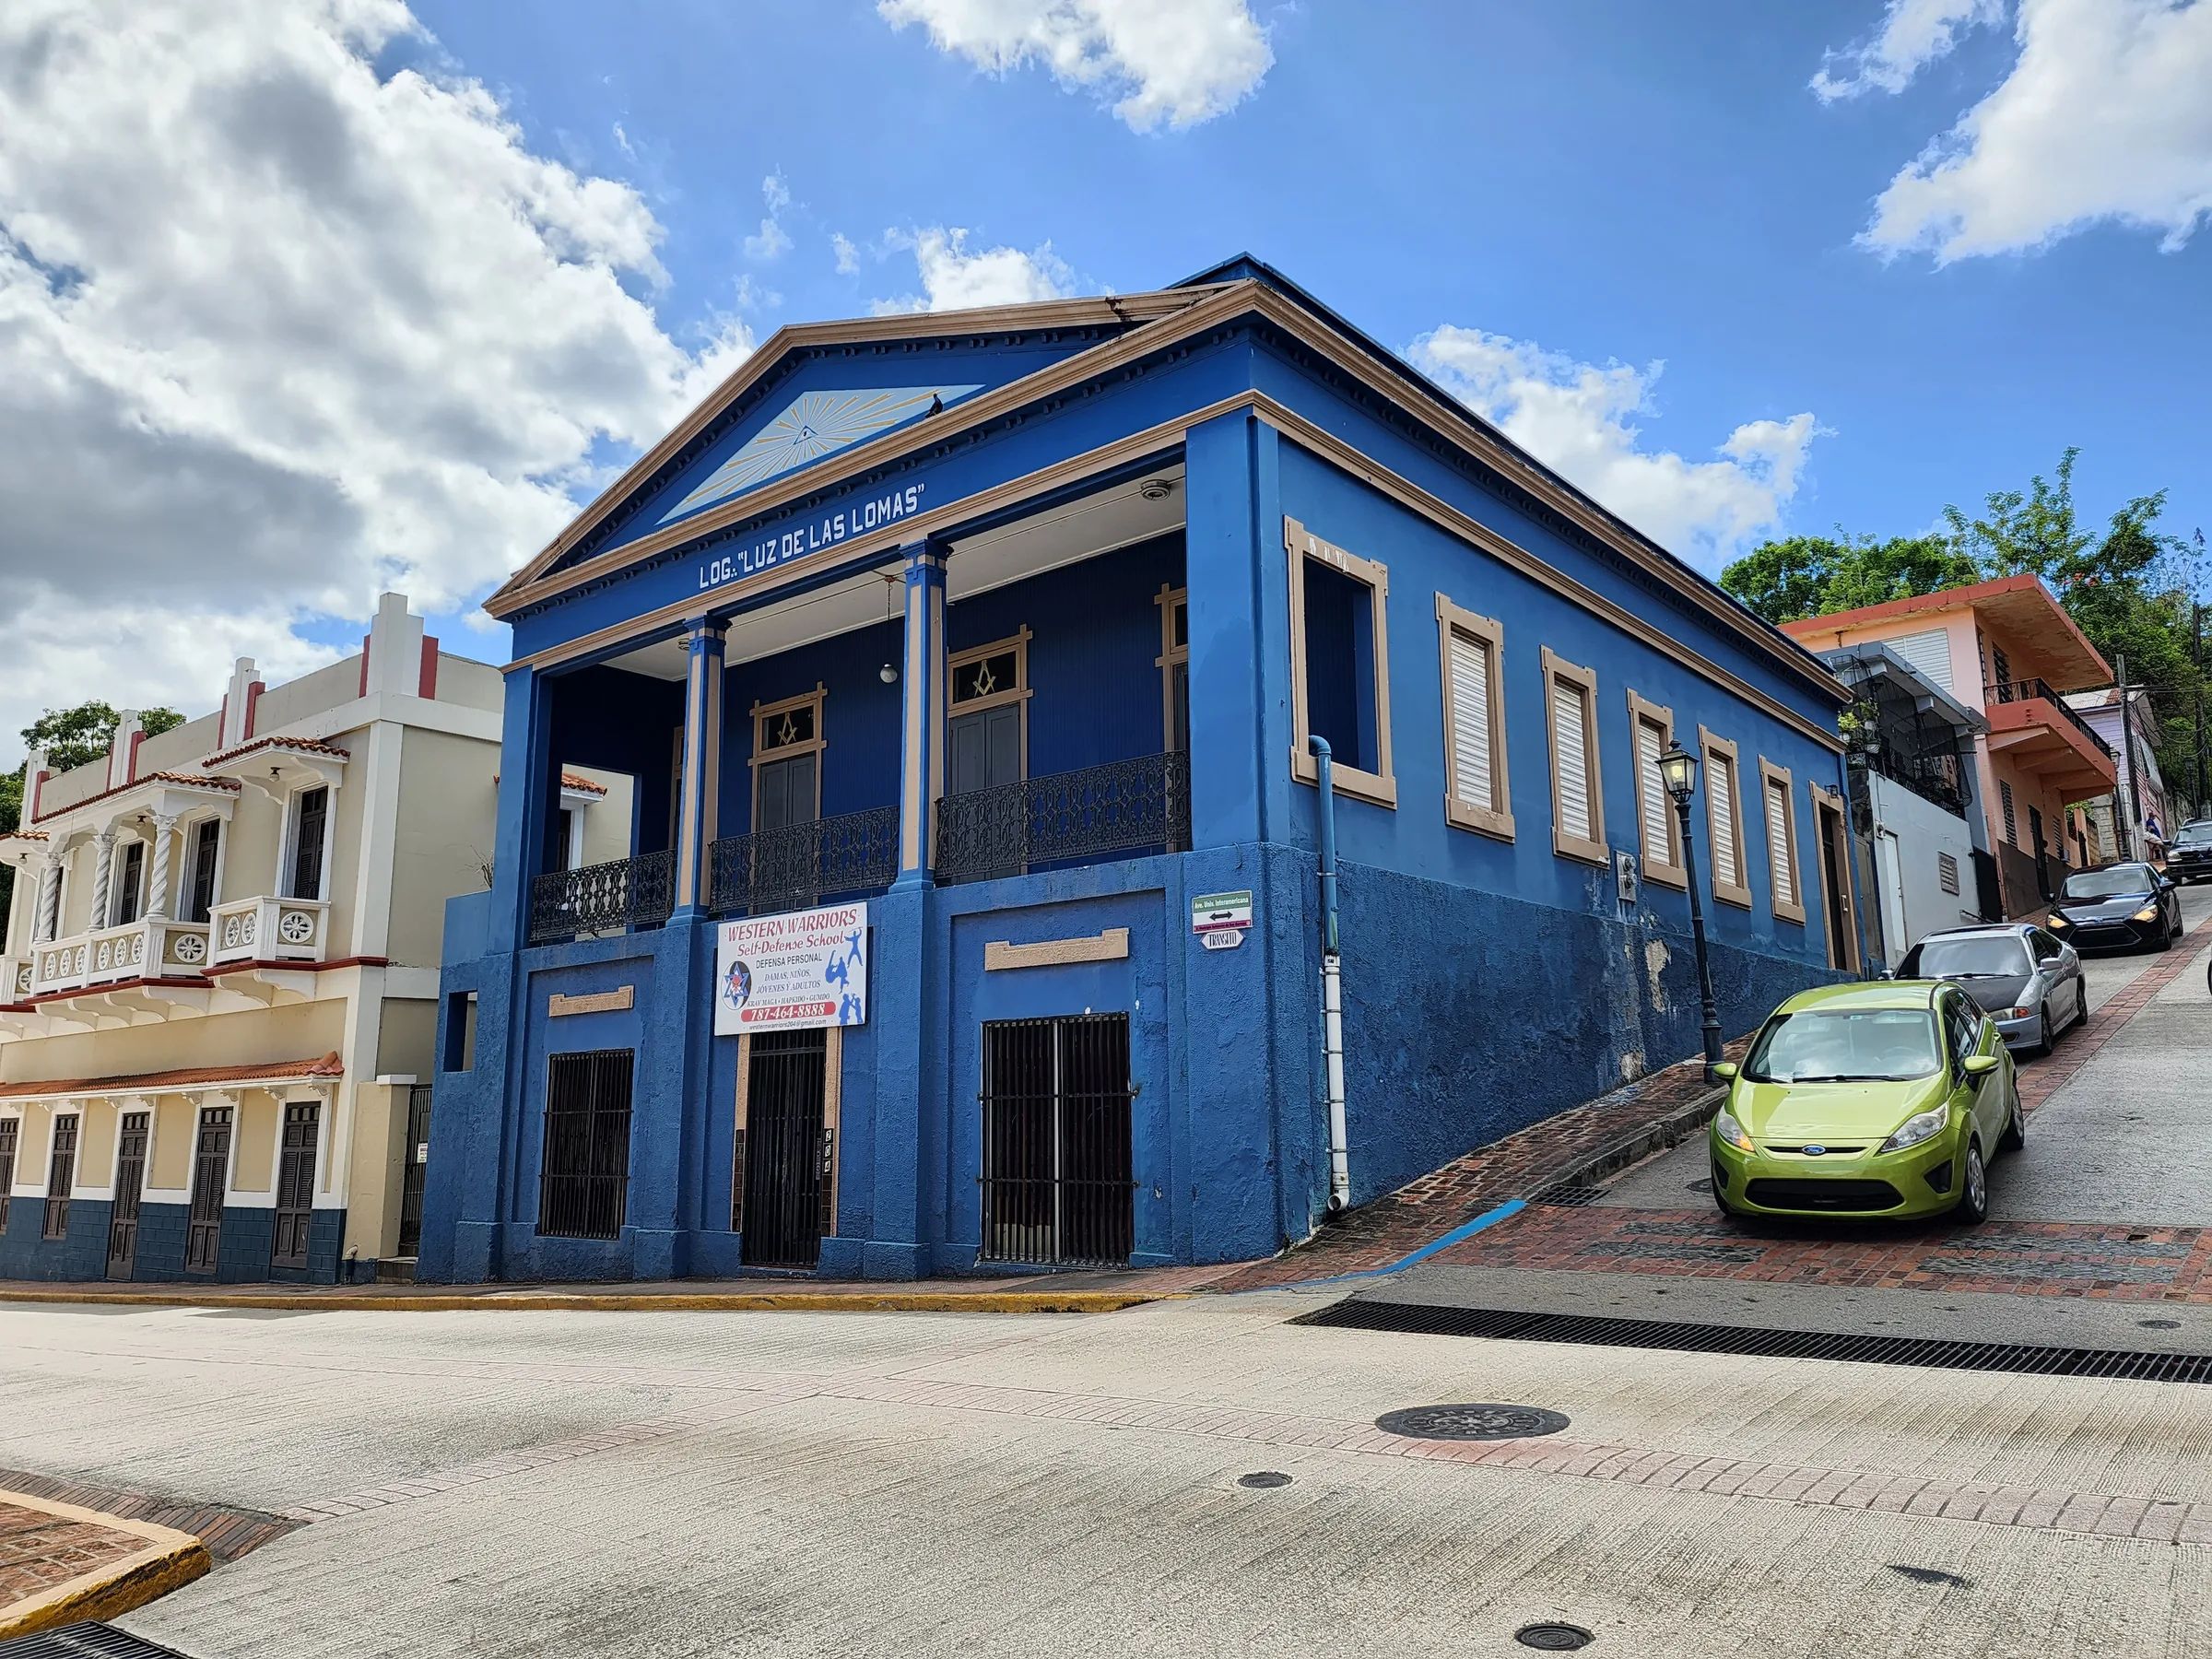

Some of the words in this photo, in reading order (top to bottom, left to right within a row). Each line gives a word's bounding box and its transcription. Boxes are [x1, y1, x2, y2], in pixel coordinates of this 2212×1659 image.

[782, 528, 806, 559] DE
[809, 513, 845, 548] LAS
[728, 920, 784, 942] WESTERN
[787, 909, 857, 934] WARRIORS
[737, 938, 804, 958] Self-Defense
[806, 930, 845, 948] School
[756, 959, 786, 970] DEFENSA
[786, 952, 822, 966] PERSONAL
[764, 971, 789, 982] DAMAS,
[756, 984, 785, 994] JÓVENES
[791, 980, 821, 991] ADULTOS
[781, 995, 806, 1005] HAPKIDO
[751, 1003, 826, 1021] 787-464-8888
[749, 1019, 827, 1030] westernwarriors204@gmail.com
